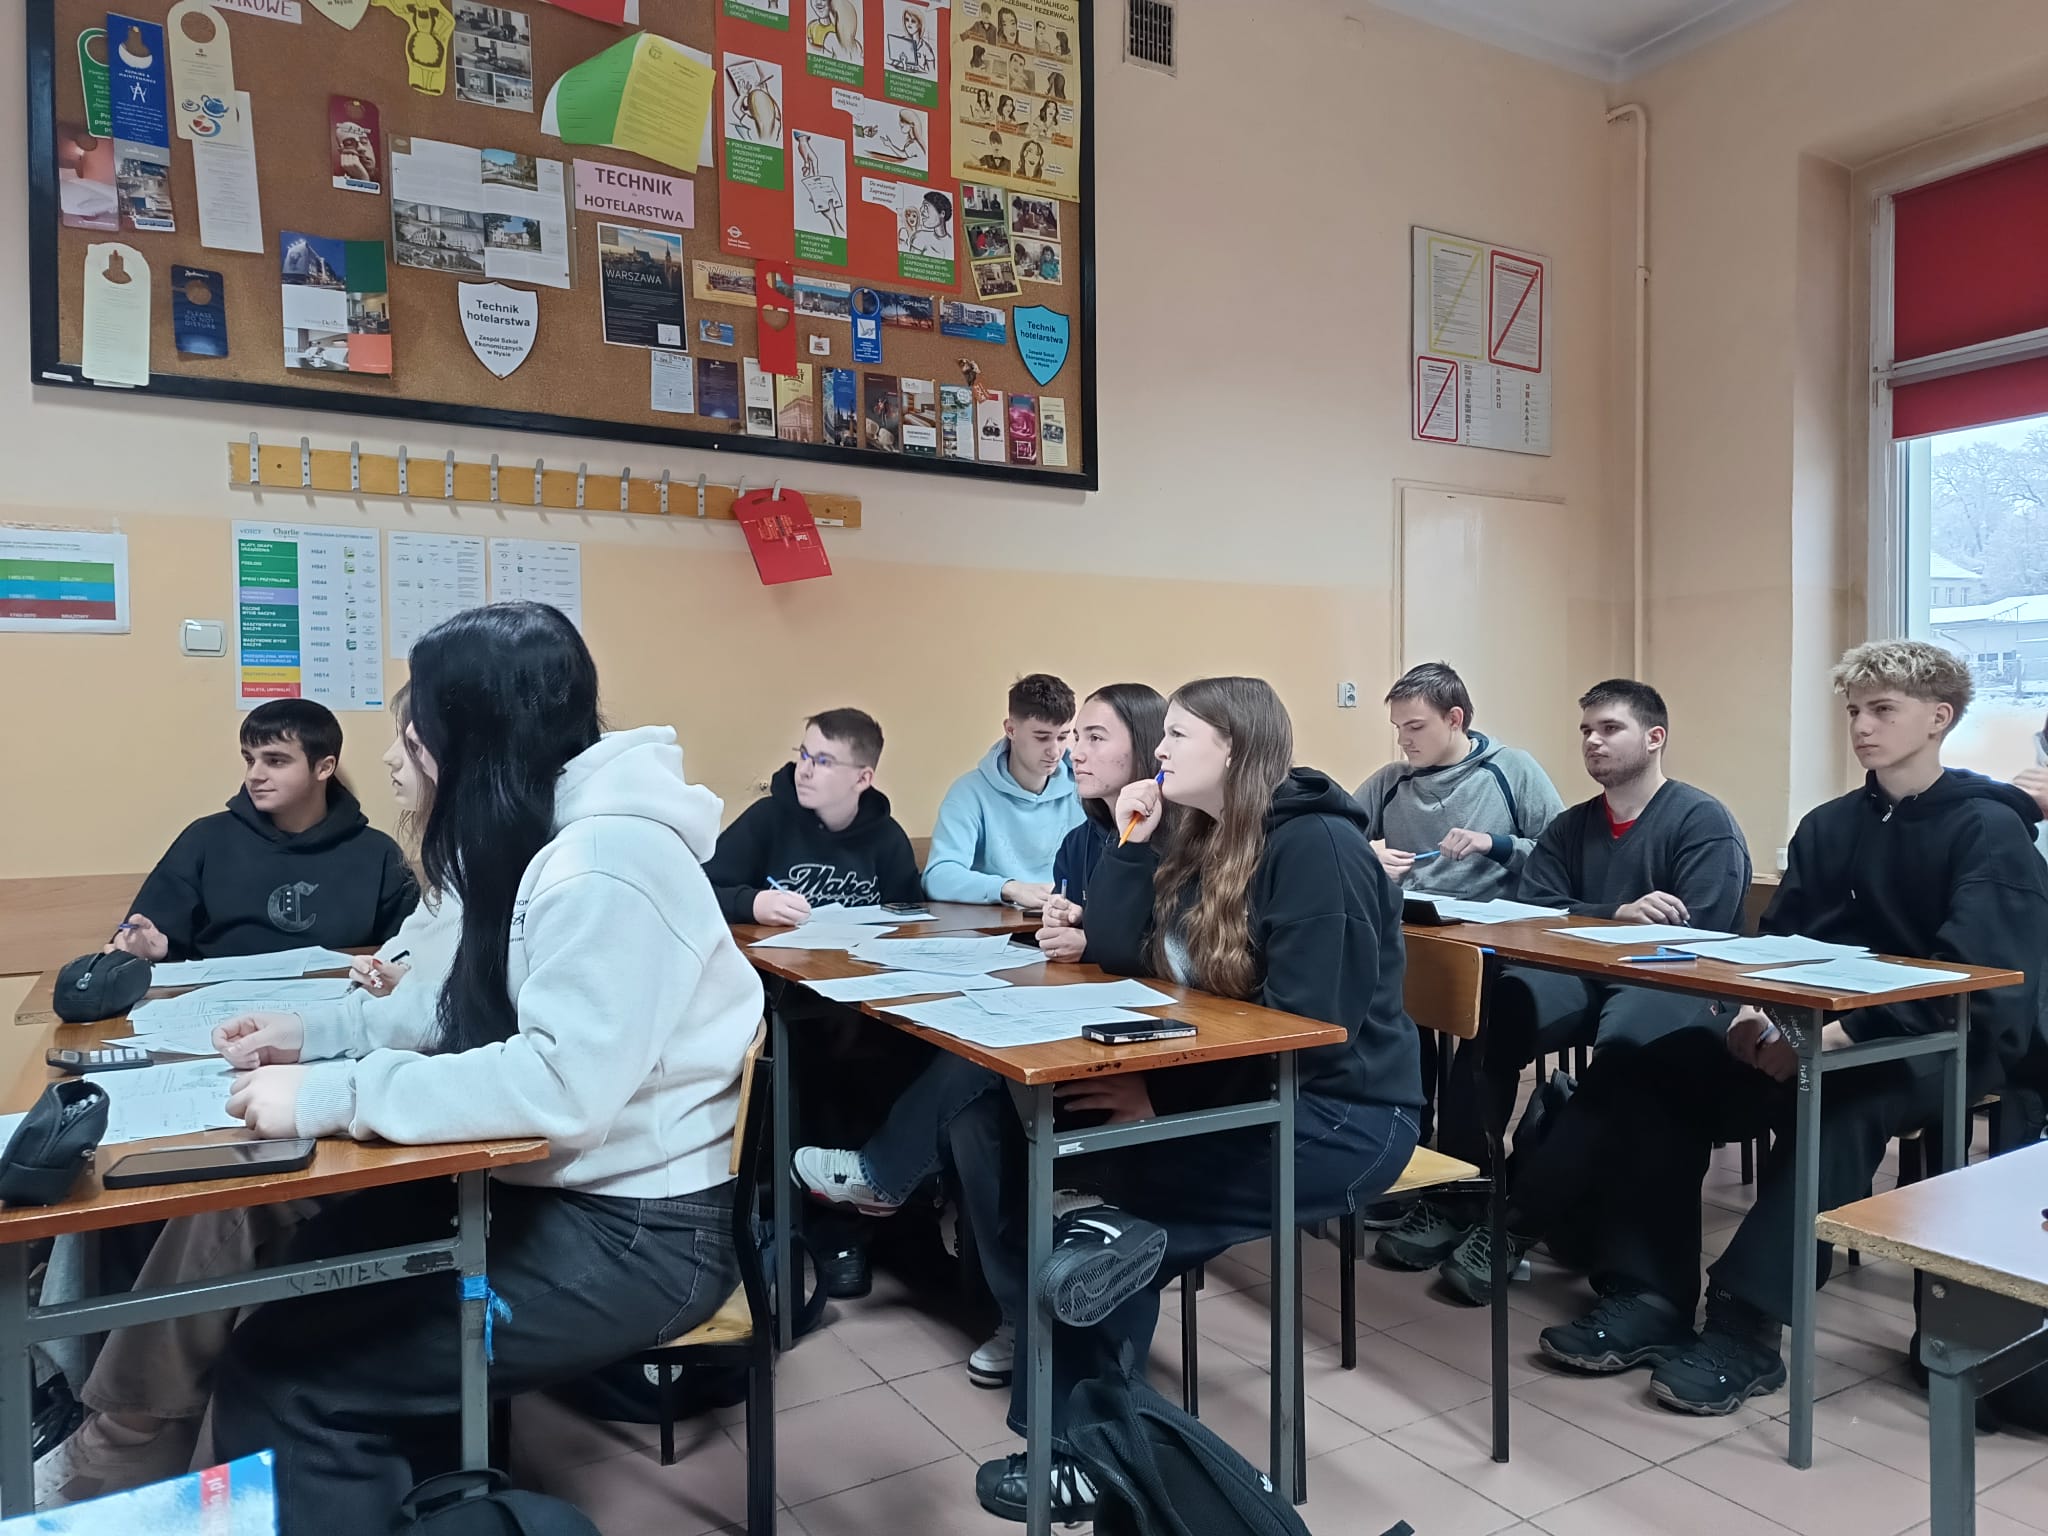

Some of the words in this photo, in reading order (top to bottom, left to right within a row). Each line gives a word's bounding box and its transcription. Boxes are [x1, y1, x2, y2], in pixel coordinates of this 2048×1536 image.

[594, 167, 673, 197] TECHNIK
[584, 194, 684, 223] HOTELARSTWA
[605, 268, 662, 285] WARSZAWA
[476, 299, 520, 314] Technik
[466, 310, 531, 327] hotelarstwa
[1027, 320, 1056, 333] Technik
[1020, 330, 1064, 345] hotelarstwa
[474, 341, 524, 352] Ekonomicznych
[273, 527, 300, 536] Charlie
